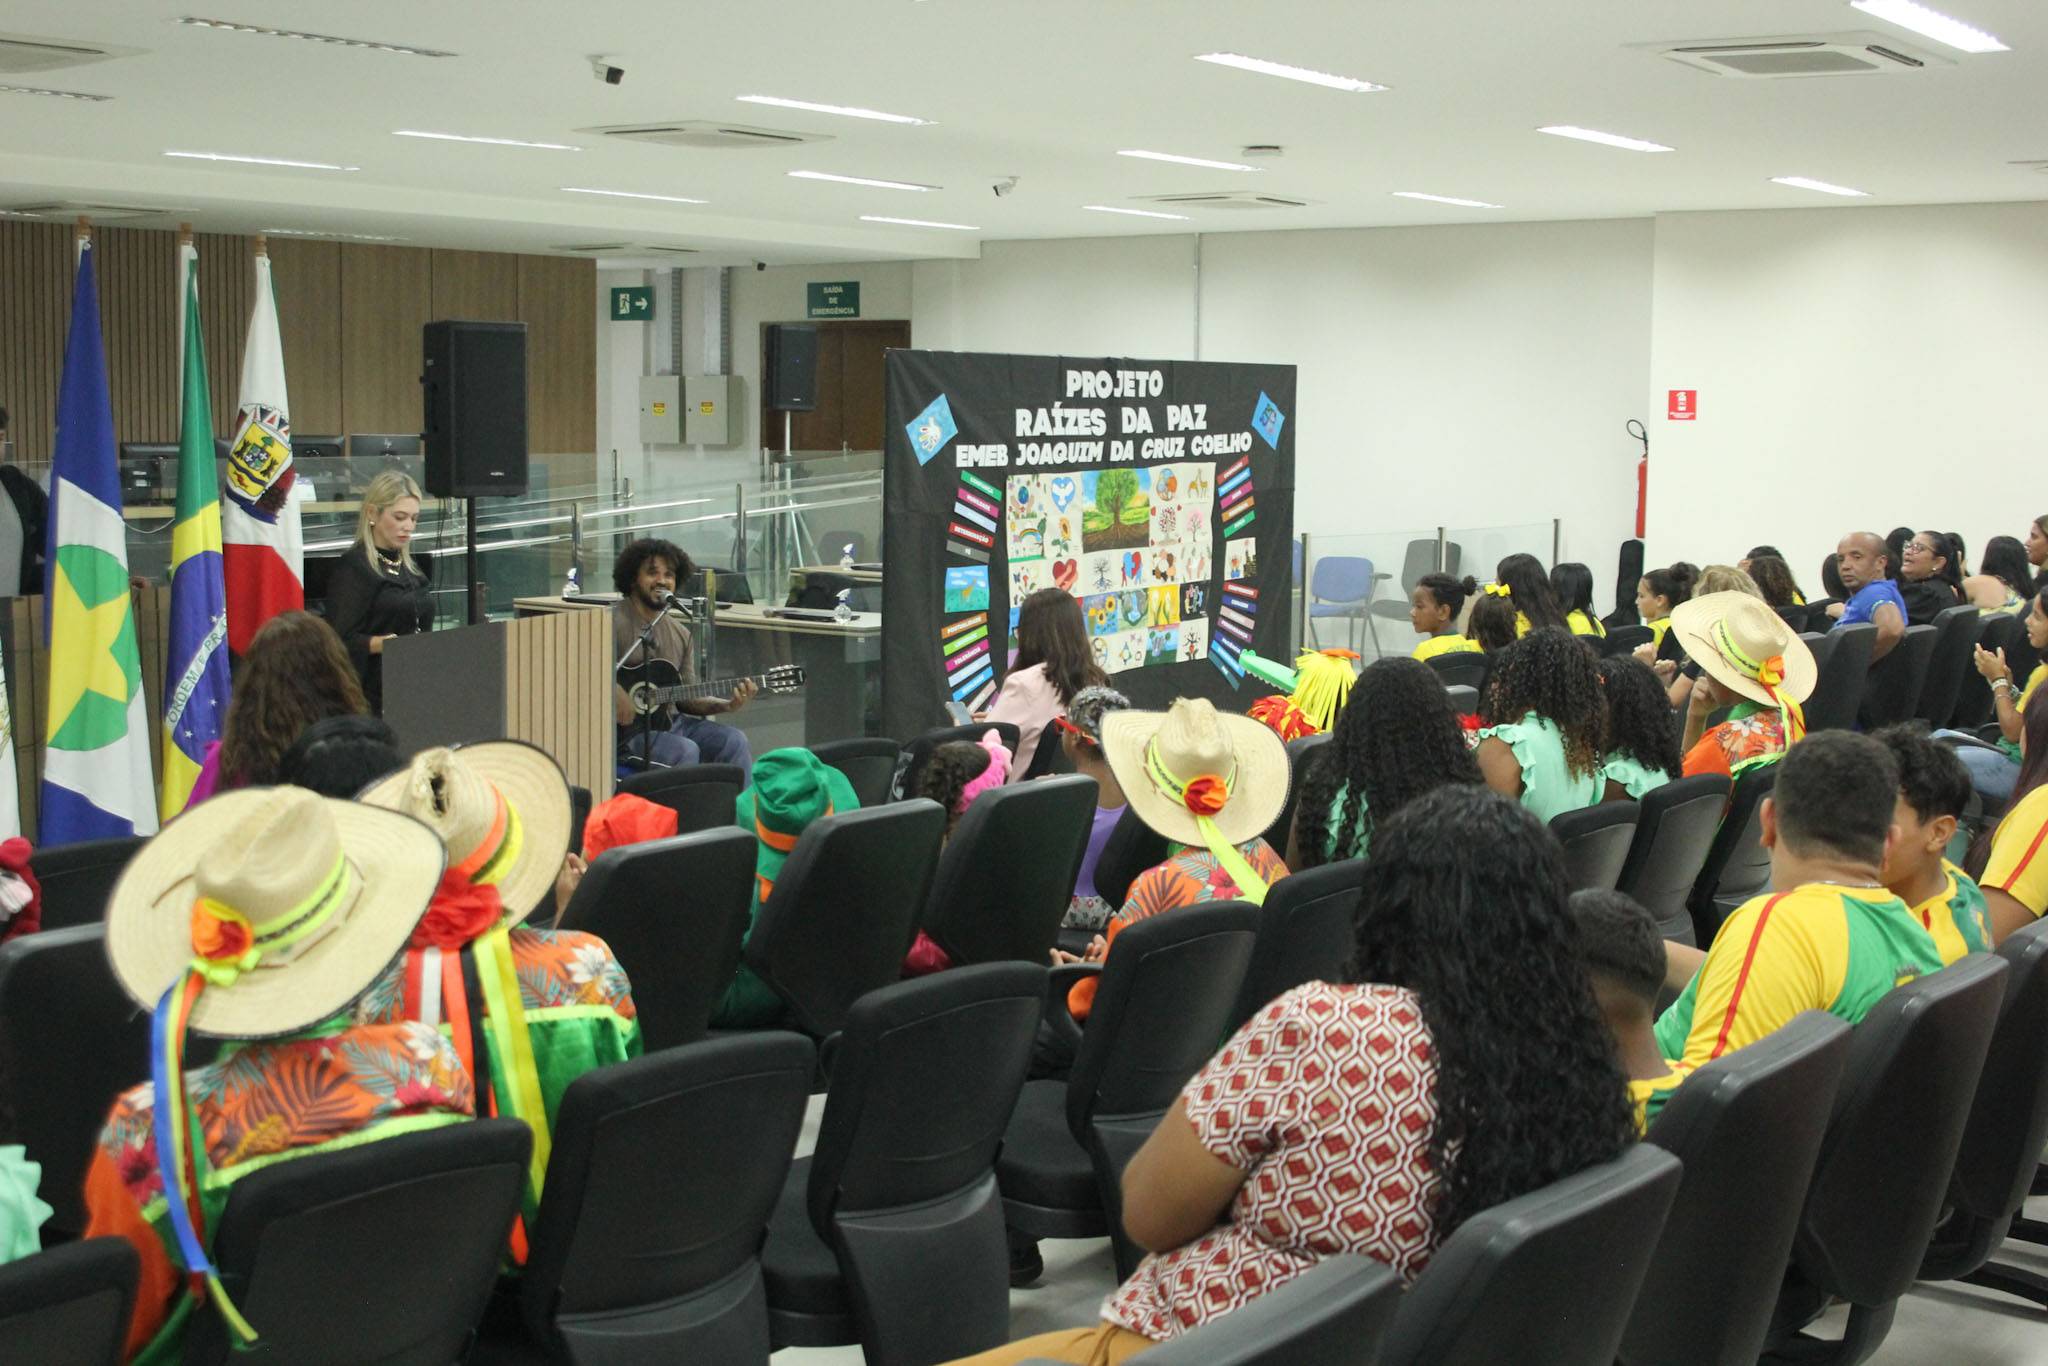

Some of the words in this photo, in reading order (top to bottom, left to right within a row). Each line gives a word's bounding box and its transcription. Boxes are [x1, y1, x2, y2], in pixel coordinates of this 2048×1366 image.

[823, 285, 843, 294] SAÍDA
[812, 306, 855, 315] EMERGÊNCIA
[1066, 370, 1163, 399] PROJETO
[1015, 401, 1107, 437] RAÍZES
[1122, 407, 1153, 434] DA
[1166, 404, 1207, 431] PAZ
[956, 444, 1008, 467] EMEB
[1015, 441, 1104, 466] JOAQUIM
[1110, 440, 1134, 462] DA
[1141, 437, 1185, 459] CRUZ
[1191, 432, 1252, 456] COELHO
[168, 670, 199, 723] ORDEM
